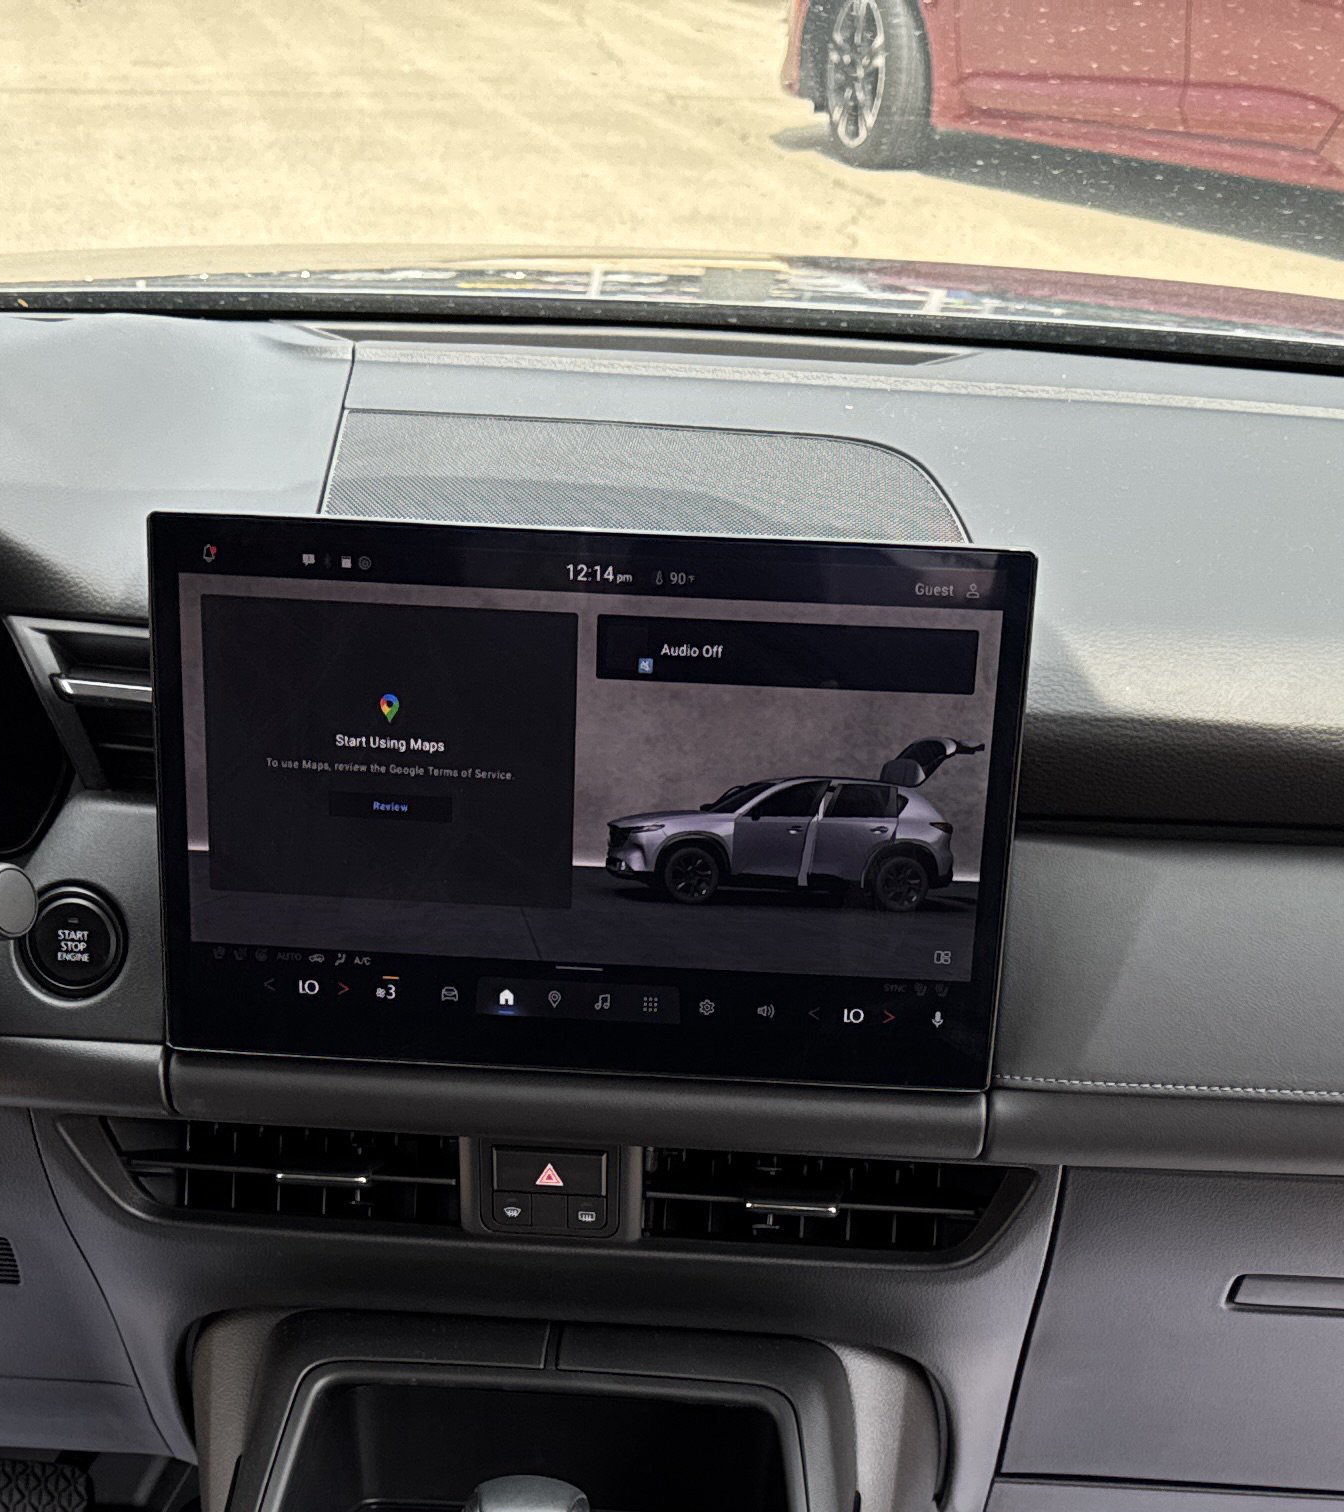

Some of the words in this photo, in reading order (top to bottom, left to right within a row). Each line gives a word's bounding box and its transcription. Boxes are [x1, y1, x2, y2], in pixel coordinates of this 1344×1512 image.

[566, 564, 614, 582] 12:14
[616, 573, 633, 584] pm
[670, 572, 686, 585] 90
[915, 583, 955, 597] Guest
[660, 643, 699, 657] Audio
[702, 645, 723, 658] Off
[335, 734, 366, 749] Start
[369, 737, 406, 752] Using
[410, 738, 445, 754] Maps
[266, 758, 278, 768] To
[281, 760, 299, 769] use
[302, 759, 331, 773] Maps,
[334, 761, 367, 772] review
[370, 763, 386, 774] the
[389, 764, 424, 777] Google
[428, 766, 458, 778] Terms
[461, 768, 472, 778] of
[373, 801, 408, 813] Review
[57, 929, 89, 941] START
[60, 941, 87, 952] STOP
[57, 952, 90, 962] ENGINE
[276, 952, 302, 962] AUTO
[353, 957, 371, 966] A/C
[298, 979, 319, 995] LO
[386, 984, 396, 999] 3
[883, 983, 906, 993] SYNC
[843, 1008, 865, 1023] LO
